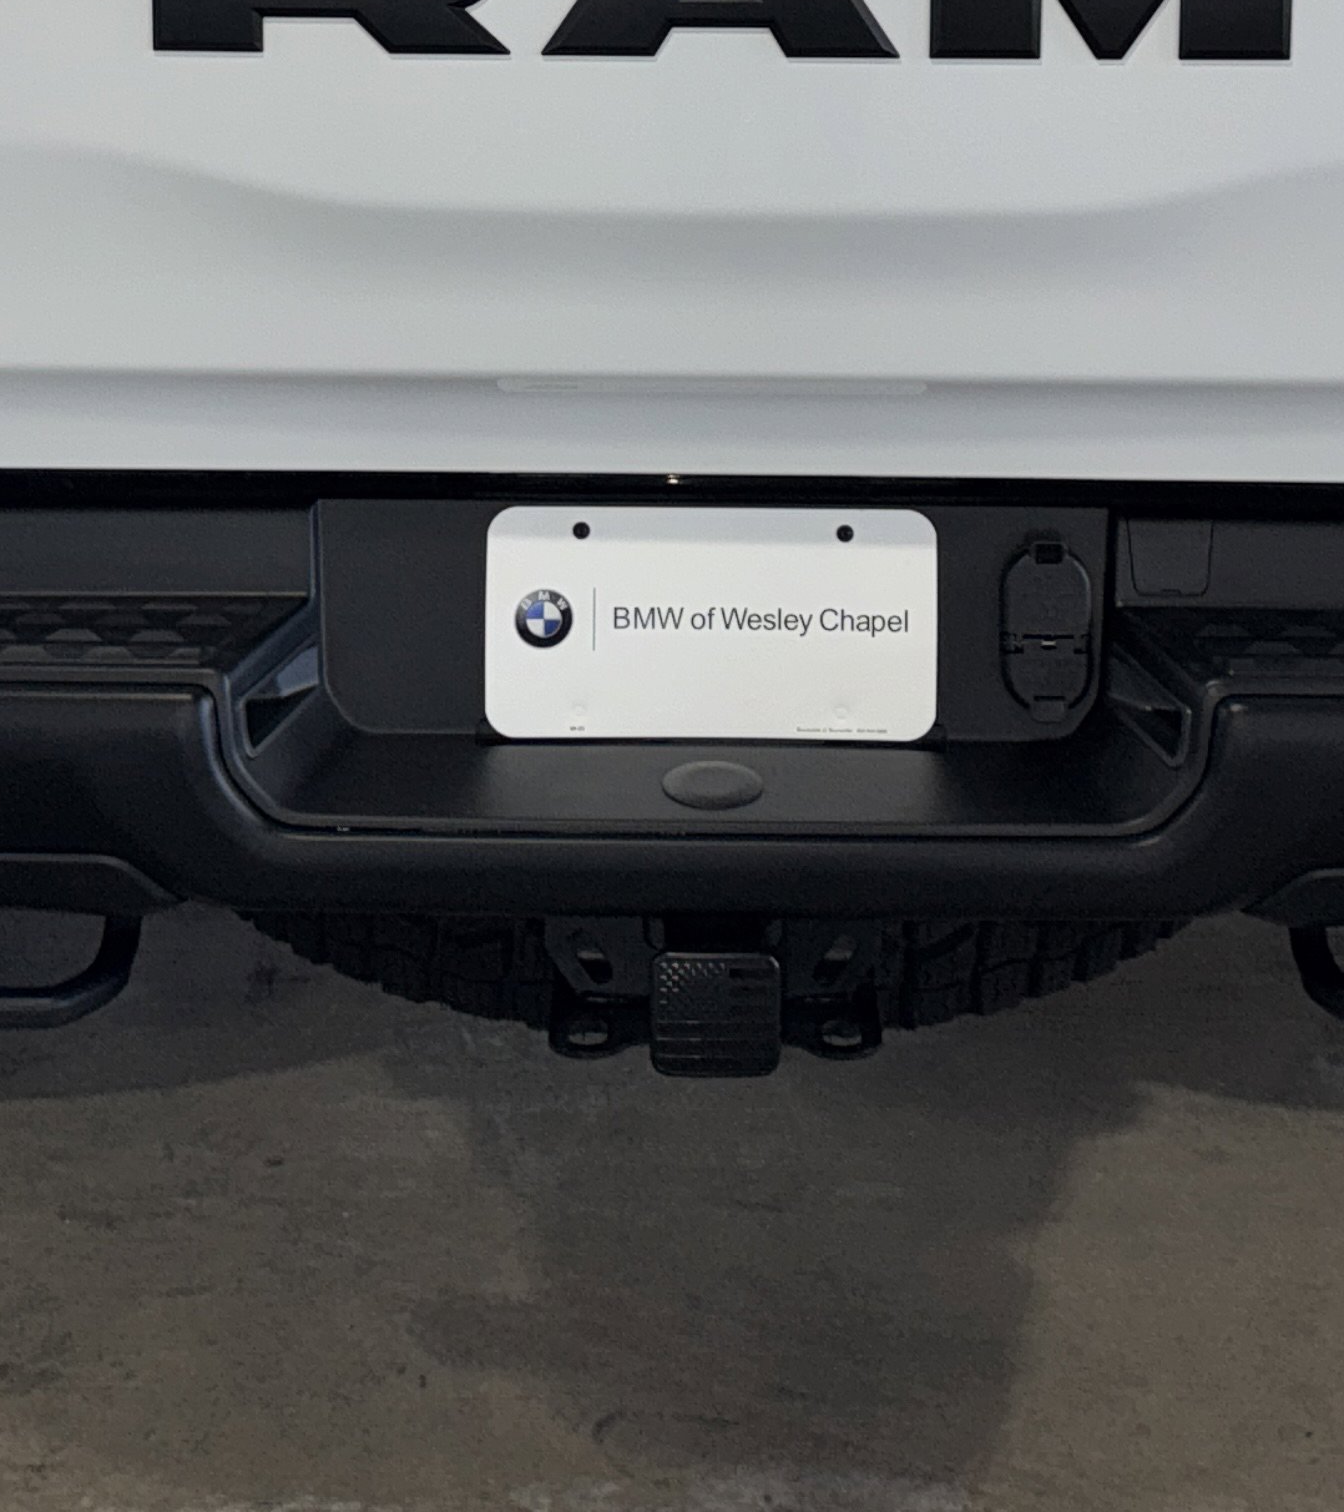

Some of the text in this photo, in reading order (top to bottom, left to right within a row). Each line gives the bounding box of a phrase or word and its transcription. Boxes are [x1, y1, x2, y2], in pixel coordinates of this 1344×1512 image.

[612, 606, 909, 638] BMW of Wesley Chapel
